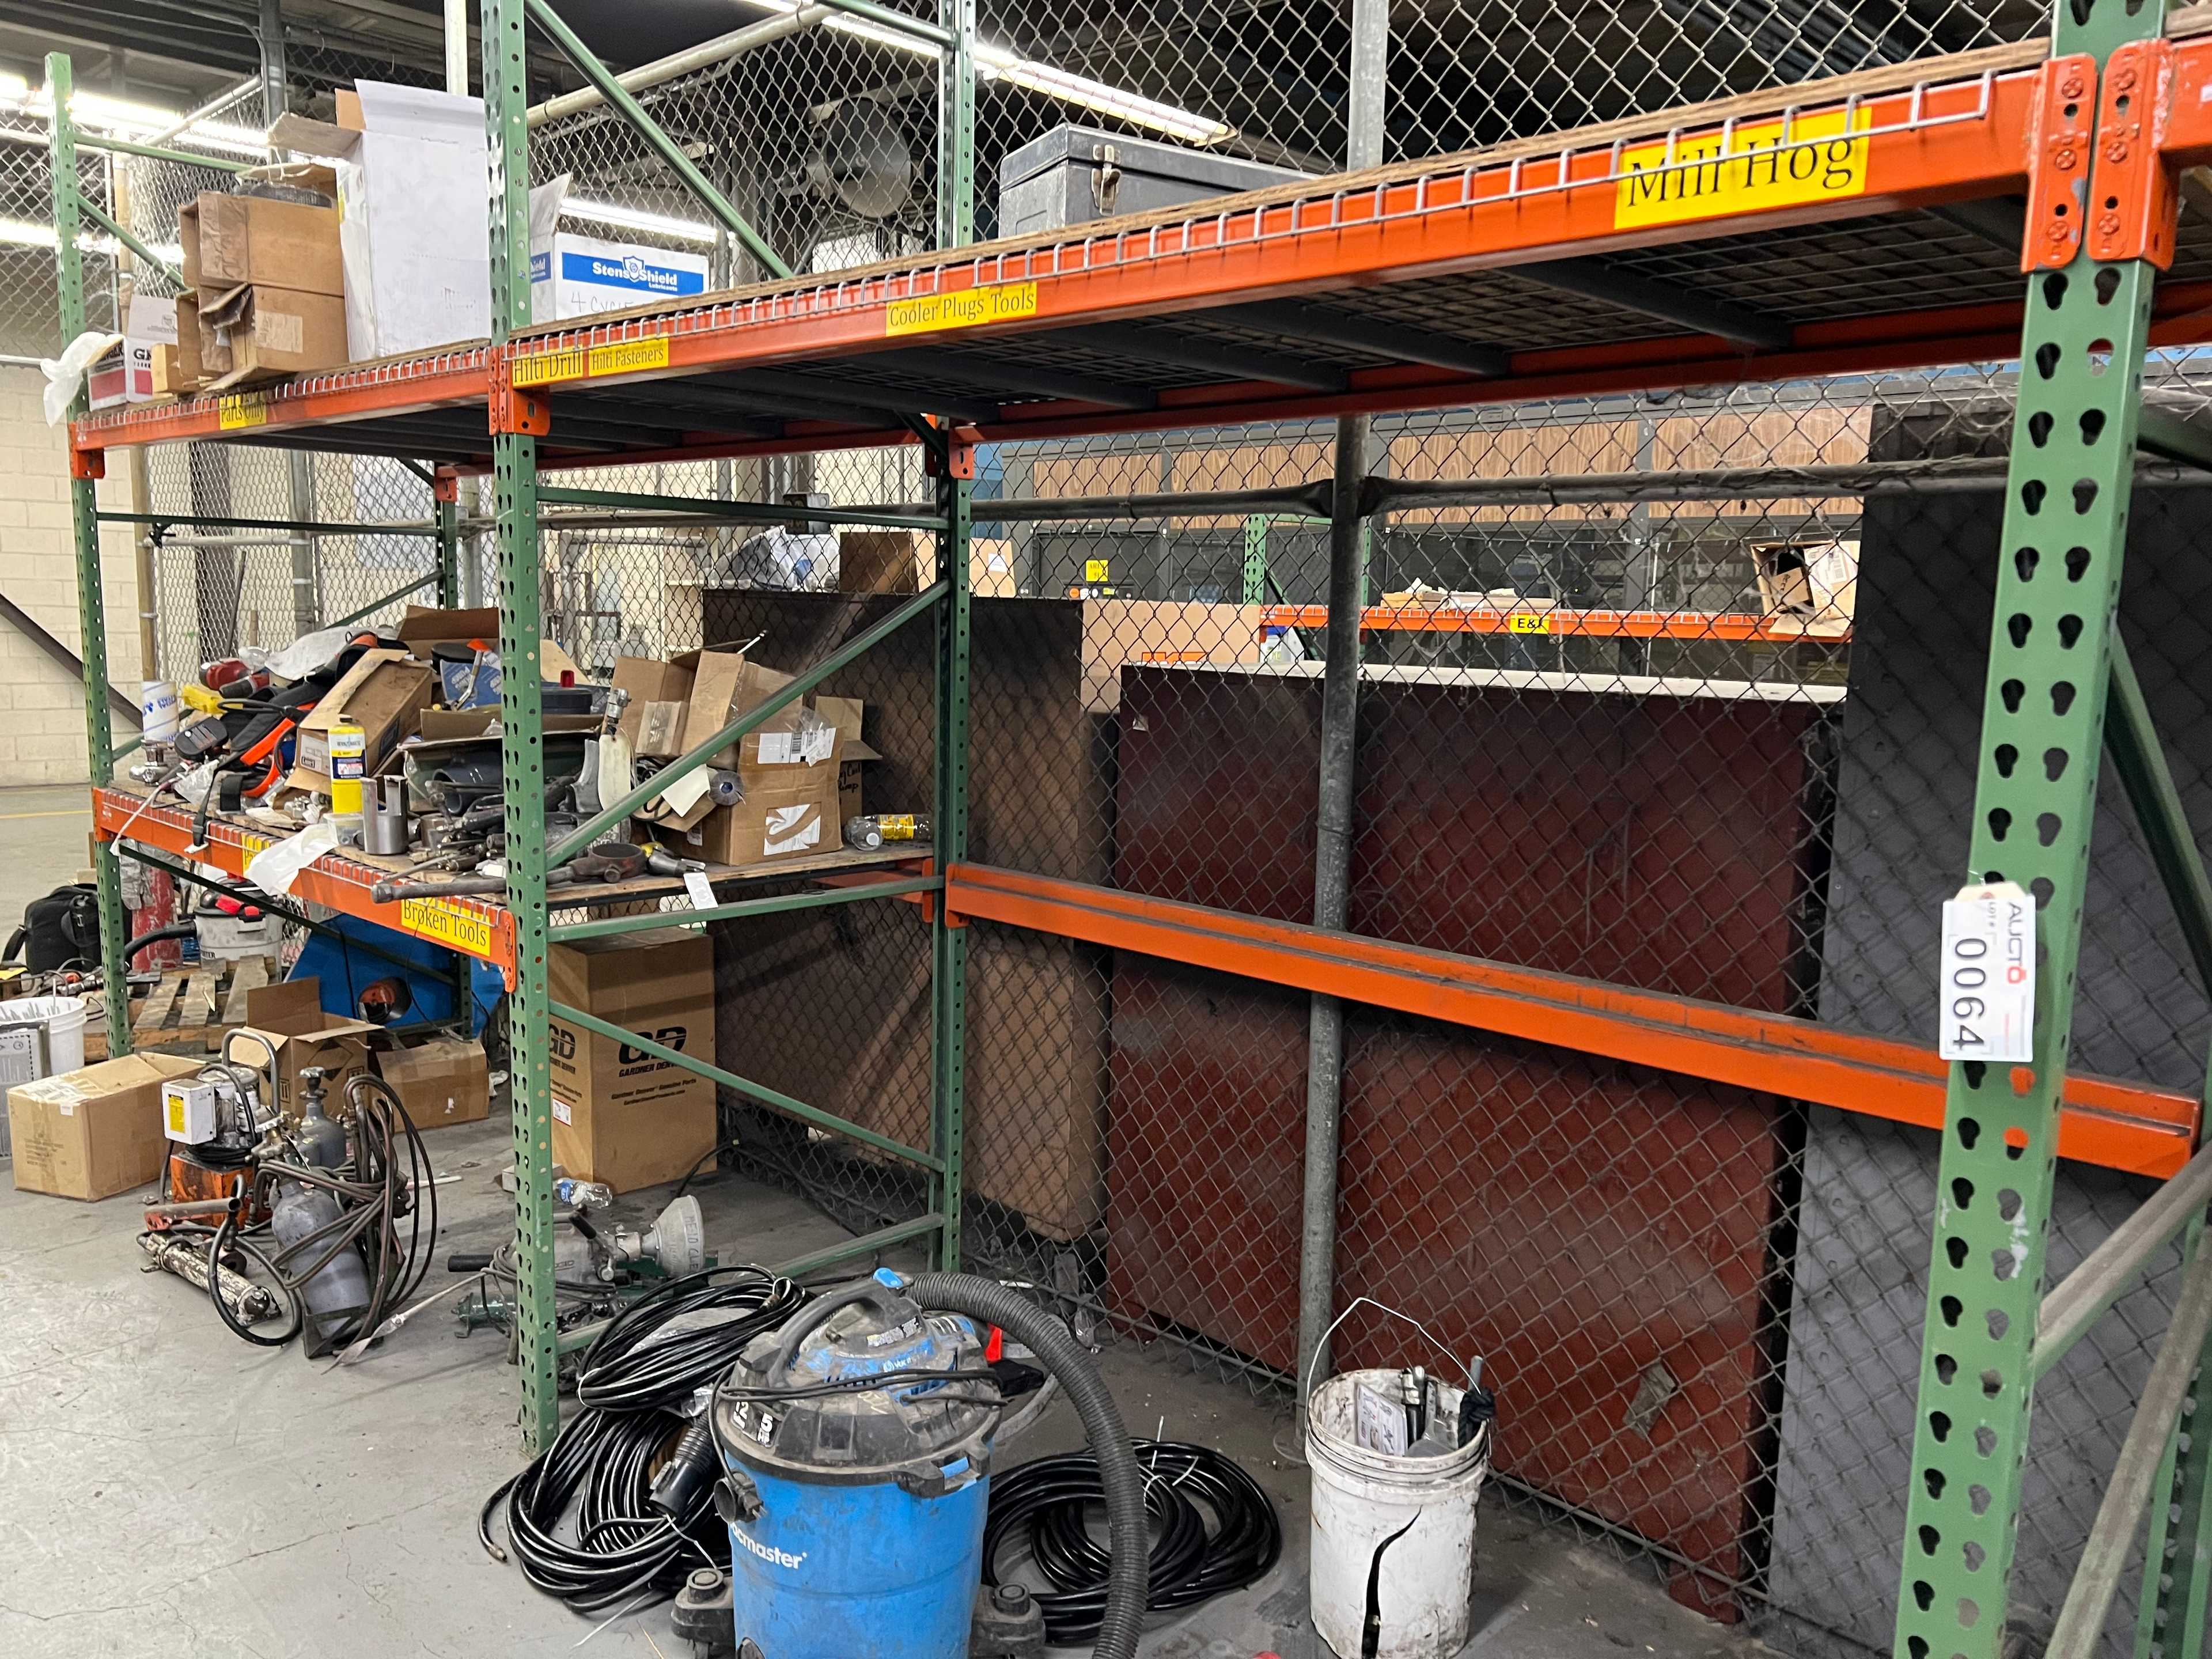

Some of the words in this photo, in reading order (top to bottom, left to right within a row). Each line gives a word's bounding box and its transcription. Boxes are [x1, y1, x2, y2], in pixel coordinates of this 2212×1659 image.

[1627, 145, 1722, 207] Mill
[1743, 137, 1854, 190] Hog
[530, 258, 546, 272] hield
[593, 262, 630, 279] Stens
[638, 270, 678, 286] Shield
[649, 283, 678, 291] Lubricants
[571, 290, 586, 313] 4
[890, 302, 939, 327] Cooler
[942, 296, 984, 321] Plugs
[990, 288, 1034, 314] Tools
[514, 357, 544, 383] Hilti
[550, 350, 581, 378] Drill
[592, 353, 612, 370] Hilti
[615, 347, 664, 367] Fasteners
[221, 404, 243, 423] Parts
[1518, 618, 1541, 628] E&
[404, 898, 447, 933] Broken
[451, 914, 486, 946] Tools
[1953, 937, 1987, 1051] 0064
[619, 1063, 655, 1077] GARDNER
[656, 1061, 678, 1070] DEN
[736, 1401, 749, 1420] 12
[760, 1412, 773, 1433] 5
[730, 1521, 803, 1569] acmaster
